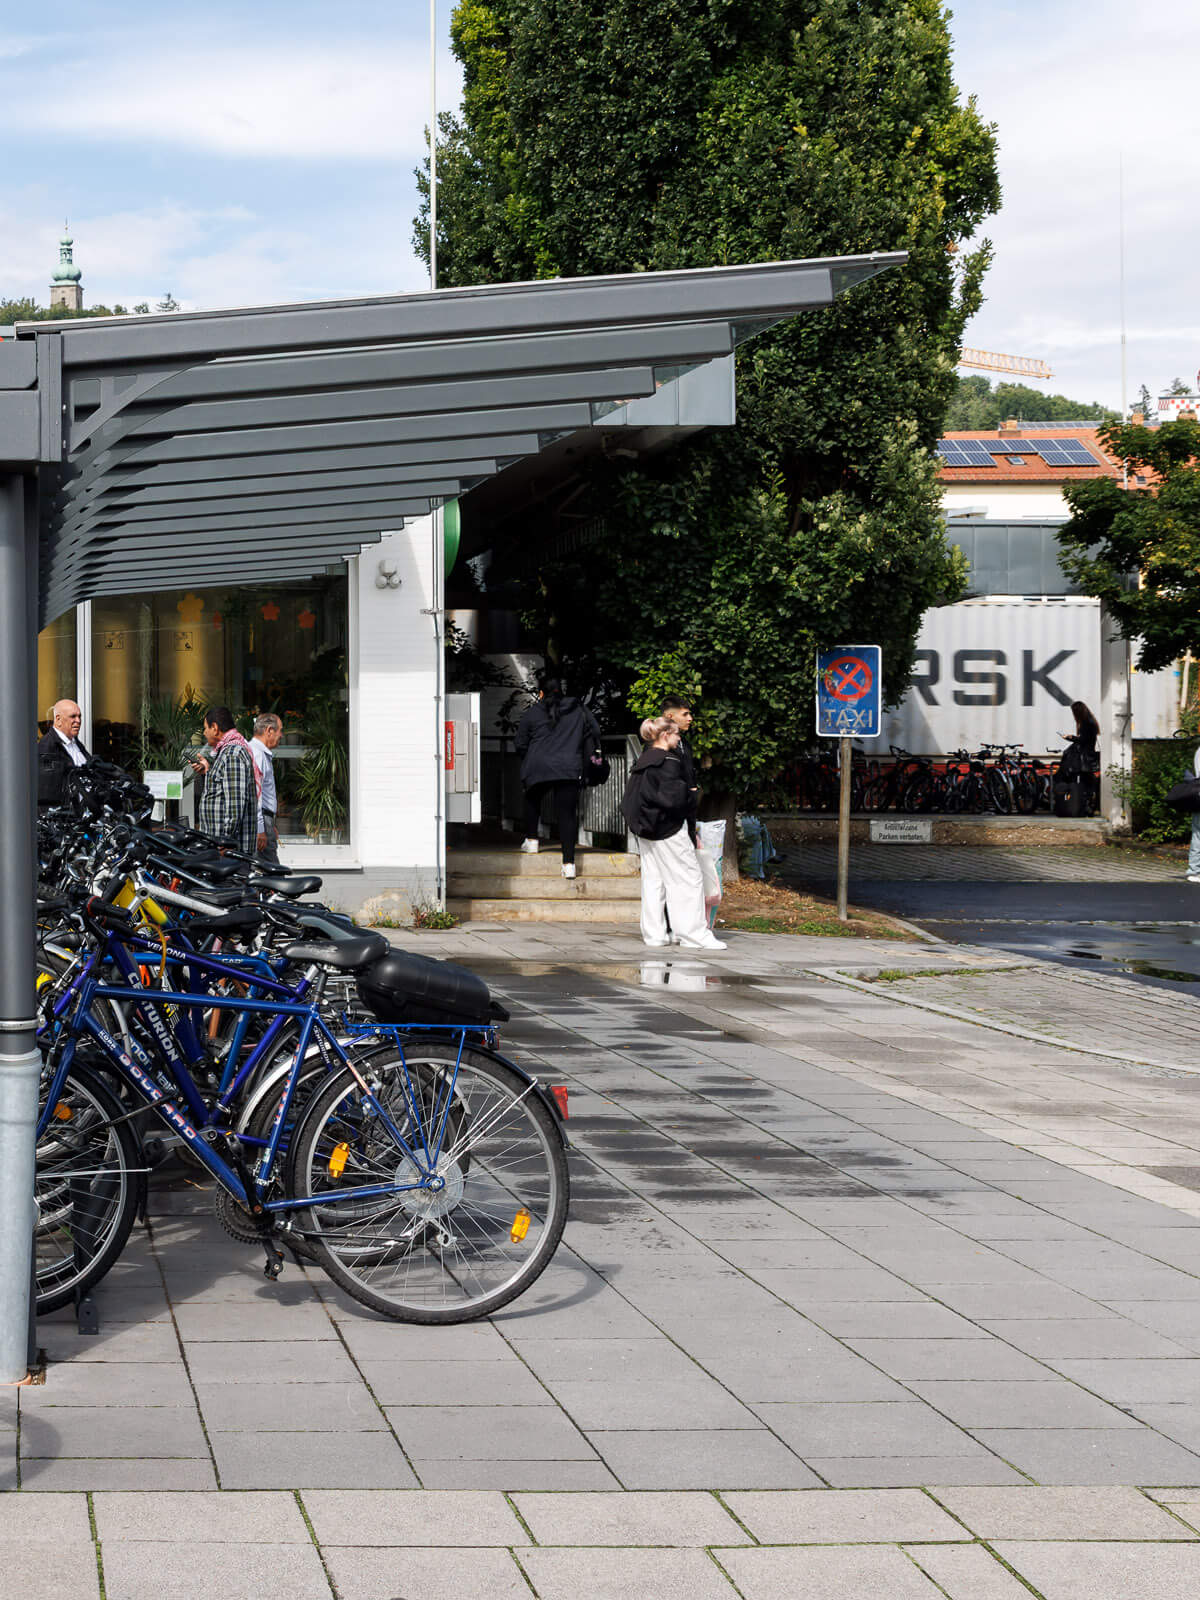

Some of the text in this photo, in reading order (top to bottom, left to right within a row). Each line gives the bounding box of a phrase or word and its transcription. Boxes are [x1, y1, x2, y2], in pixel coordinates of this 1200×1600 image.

[824, 709, 873, 728] TAXI
[878, 832, 923, 840] Parken verboten
[127, 972, 179, 1061] CETURION
